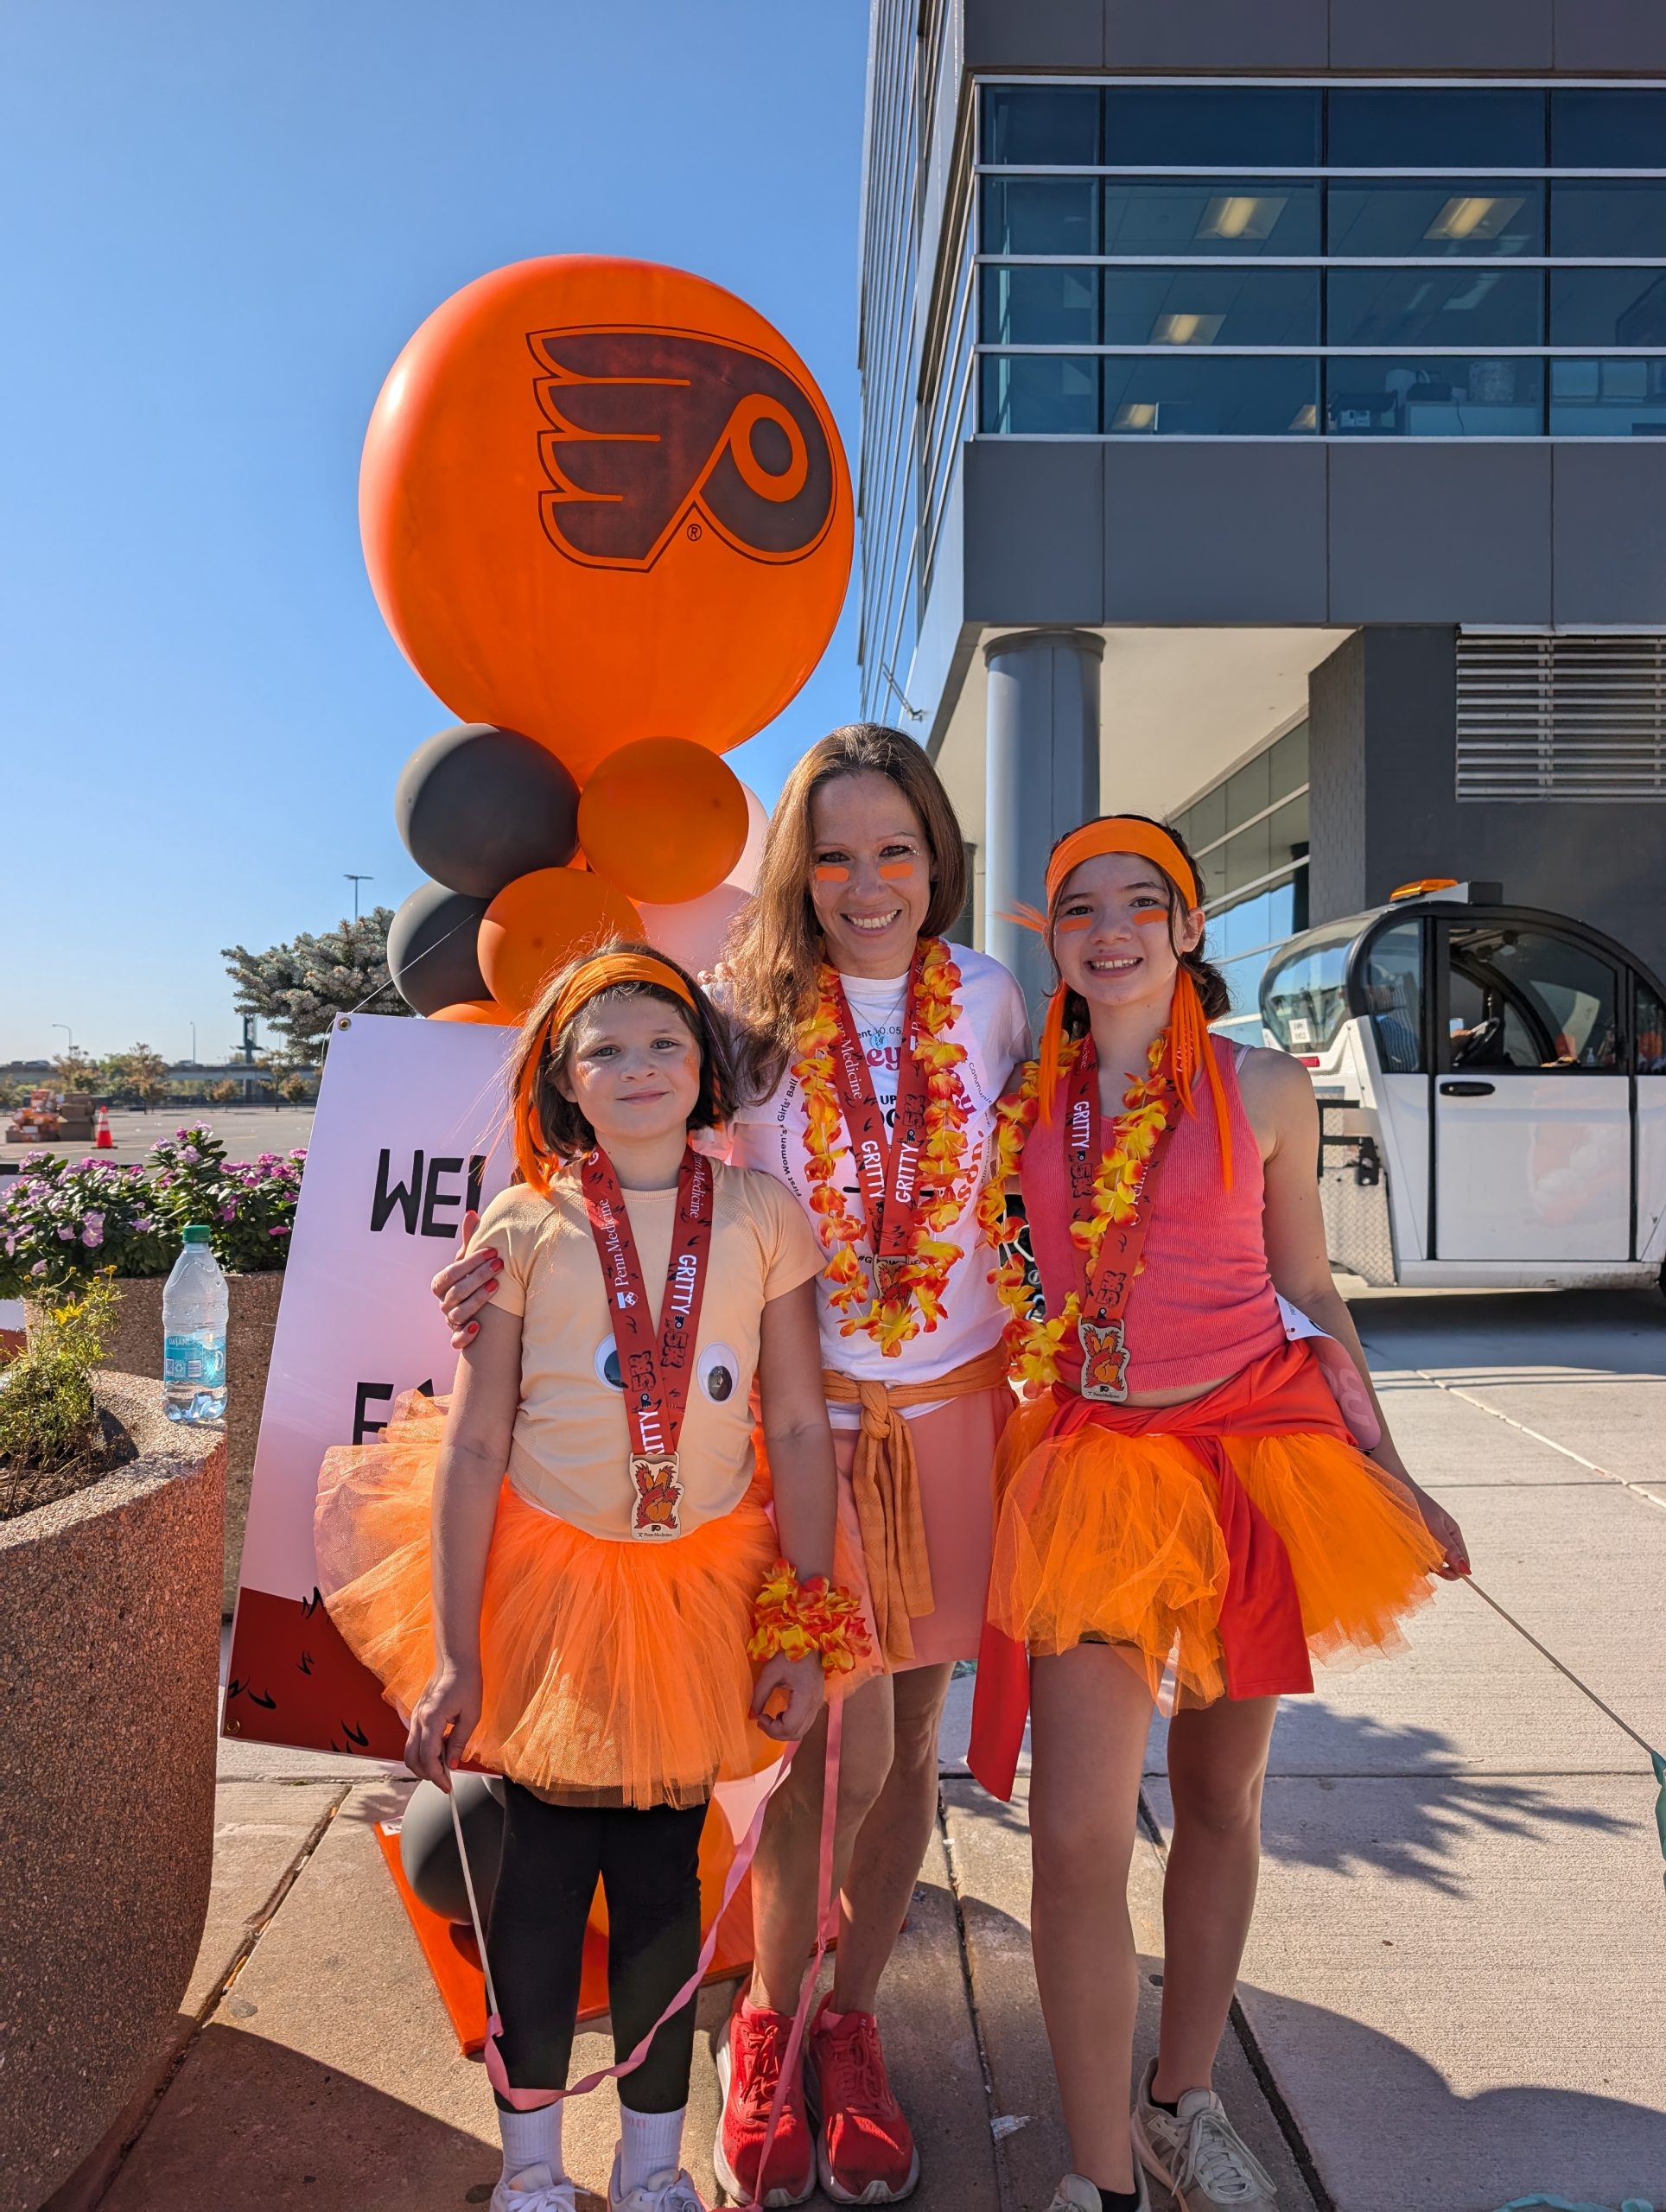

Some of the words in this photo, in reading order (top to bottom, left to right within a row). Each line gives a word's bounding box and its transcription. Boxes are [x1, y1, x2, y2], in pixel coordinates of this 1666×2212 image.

[786, 1078, 798, 1098] Ball
[841, 1038, 862, 1100] Medicine
[968, 1062, 993, 1106] Communit
[1071, 1101, 1090, 1148] GRITTY
[779, 1128, 791, 1176] Women's
[861, 1140, 885, 1198] GRITTY
[895, 1142, 919, 1203] GRITTY
[690, 1171, 706, 1219] Medicine
[787, 1176, 802, 1198] First
[599, 1198, 621, 1252] Medicine
[614, 1253, 629, 1287] Penn
[671, 1255, 696, 1315] GRITTY
